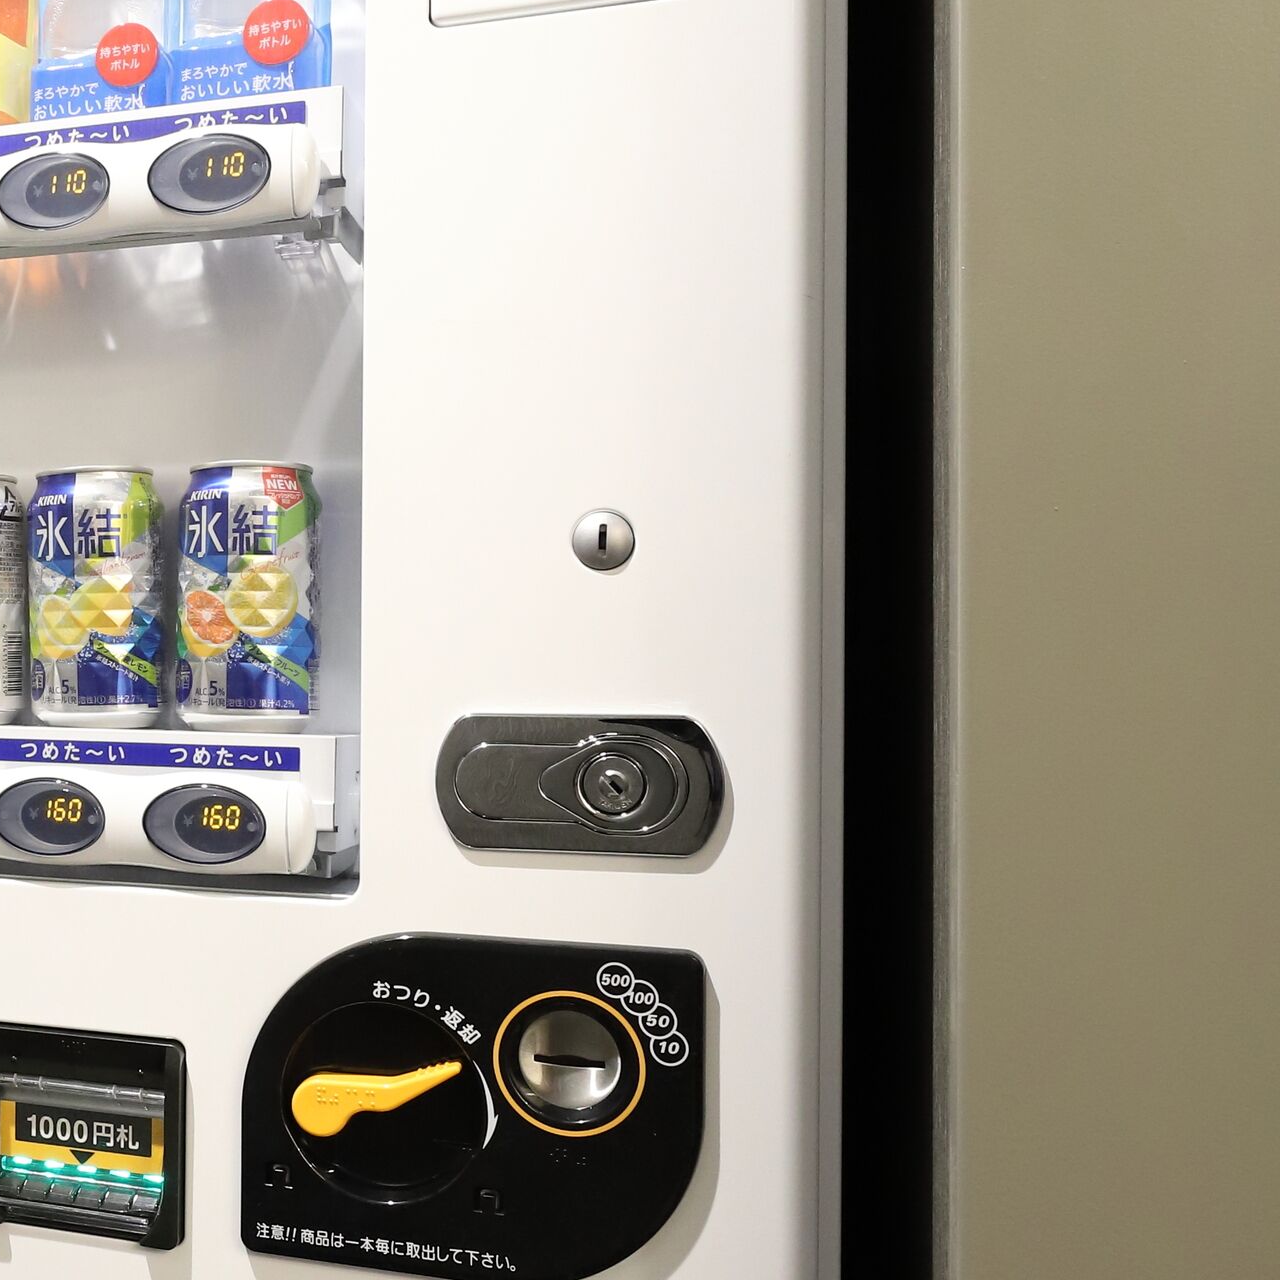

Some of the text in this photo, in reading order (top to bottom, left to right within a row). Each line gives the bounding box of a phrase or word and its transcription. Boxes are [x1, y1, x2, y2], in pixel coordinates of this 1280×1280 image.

[248, 18, 302, 38] 持ちやすい
[259, 34, 291, 49] ボトル
[110, 58, 140, 71] ボトル
[180, 62, 247, 82] まろやかで
[33, 82, 99, 102] まろやかで
[206, 152, 246, 178] 110
[50, 169, 87, 195] 110
[265, 478, 298, 491] NEW
[37, 494, 68, 508] KIRIN
[190, 488, 221, 502] KIRIN
[36, 508, 121, 562] 氷結
[188, 504, 279, 559] 氷結
[45, 797, 83, 823] 160
[201, 804, 242, 831] 160
[599, 971, 631, 988] 500
[627, 989, 655, 1006] 100
[372, 980, 481, 1047] おつり・返却
[645, 1014, 671, 1028] 50
[659, 1040, 680, 1055] 10
[26, 1113, 140, 1151] 1000円札
